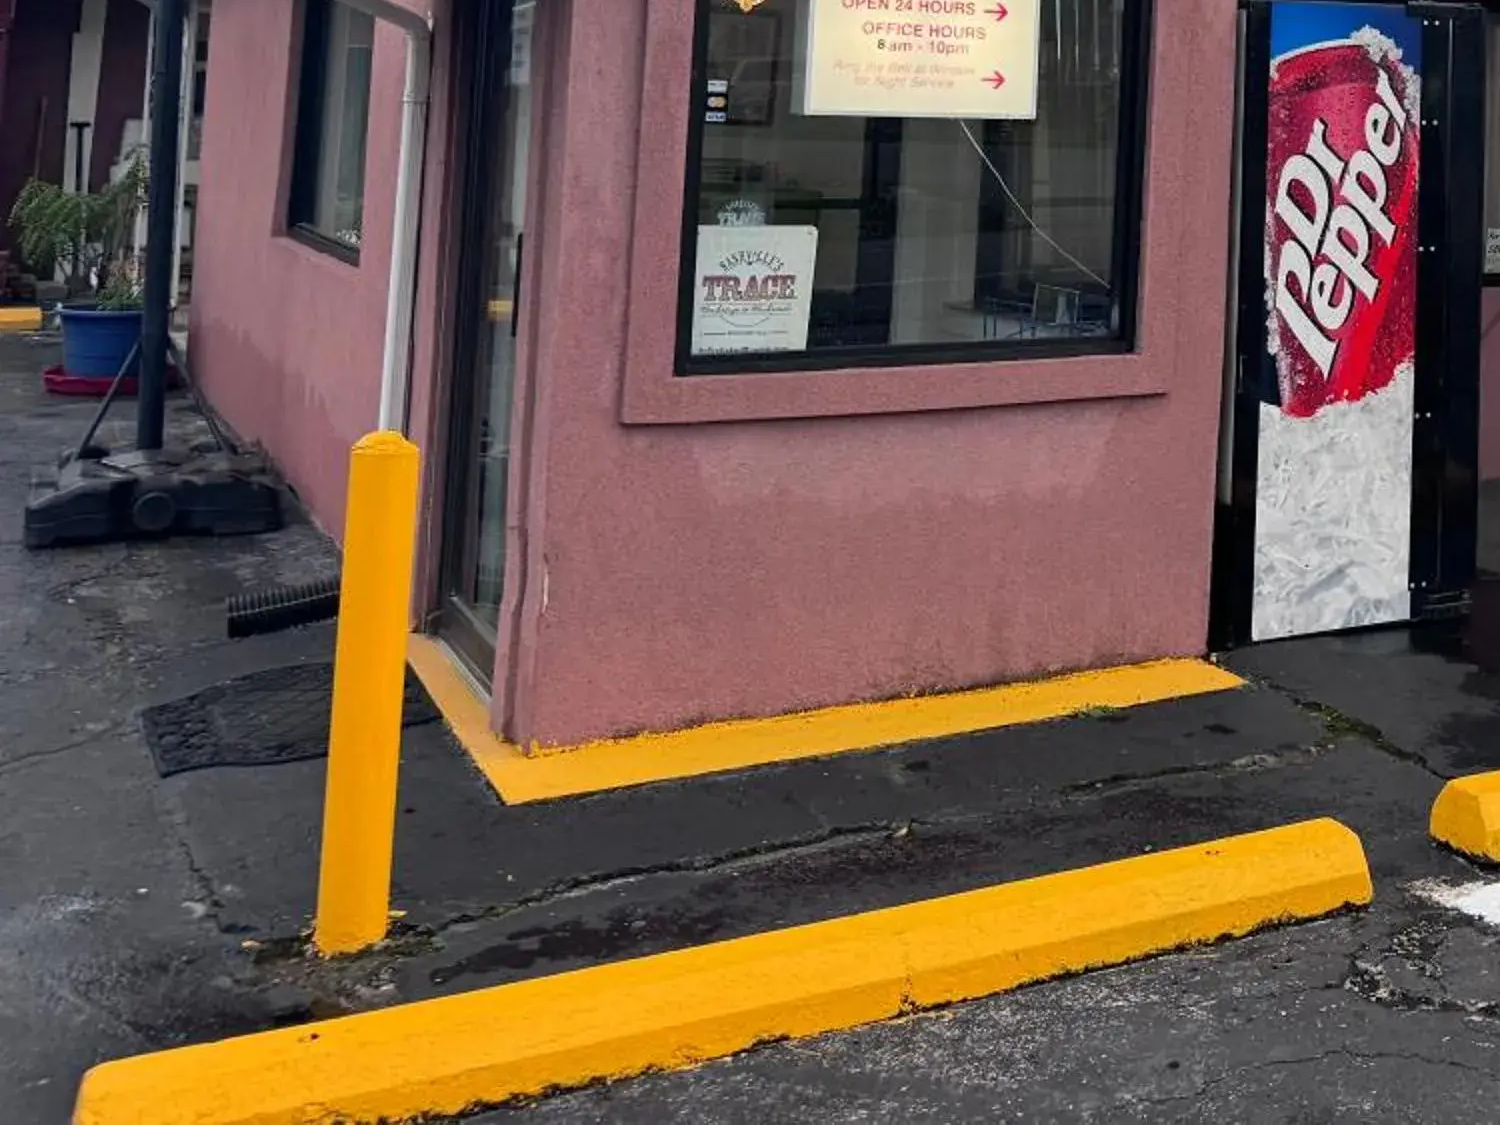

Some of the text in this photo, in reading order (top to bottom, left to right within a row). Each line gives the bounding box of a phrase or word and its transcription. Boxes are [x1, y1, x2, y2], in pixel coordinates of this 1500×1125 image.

[862, 21, 987, 40] OFFICE HOURS
[1275, 118, 1345, 256] Dr
[1276, 66, 1407, 379] Pepper
[702, 274, 798, 302] TRACE
